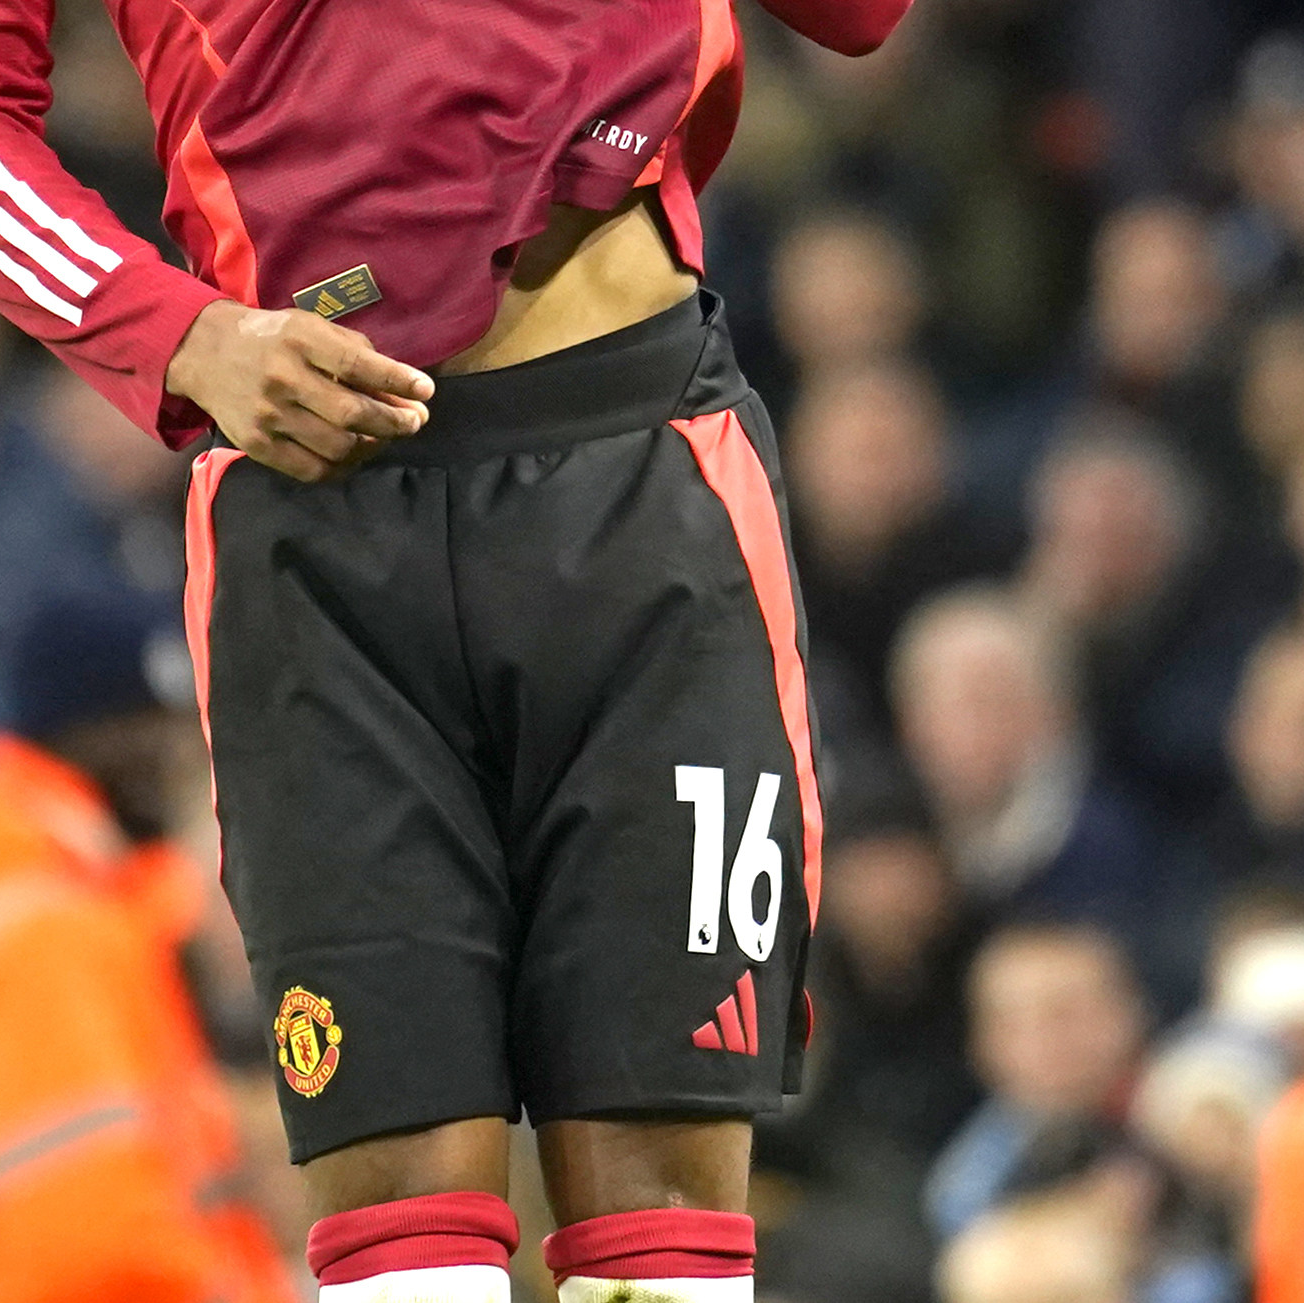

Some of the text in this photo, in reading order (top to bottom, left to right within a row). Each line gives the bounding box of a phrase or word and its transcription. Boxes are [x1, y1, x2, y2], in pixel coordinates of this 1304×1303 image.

[585, 119, 648, 155] T.RDY
[674, 764, 784, 963] 16
[278, 994, 328, 1038] MANCHESTER
[295, 1063, 331, 1089] UNITED
